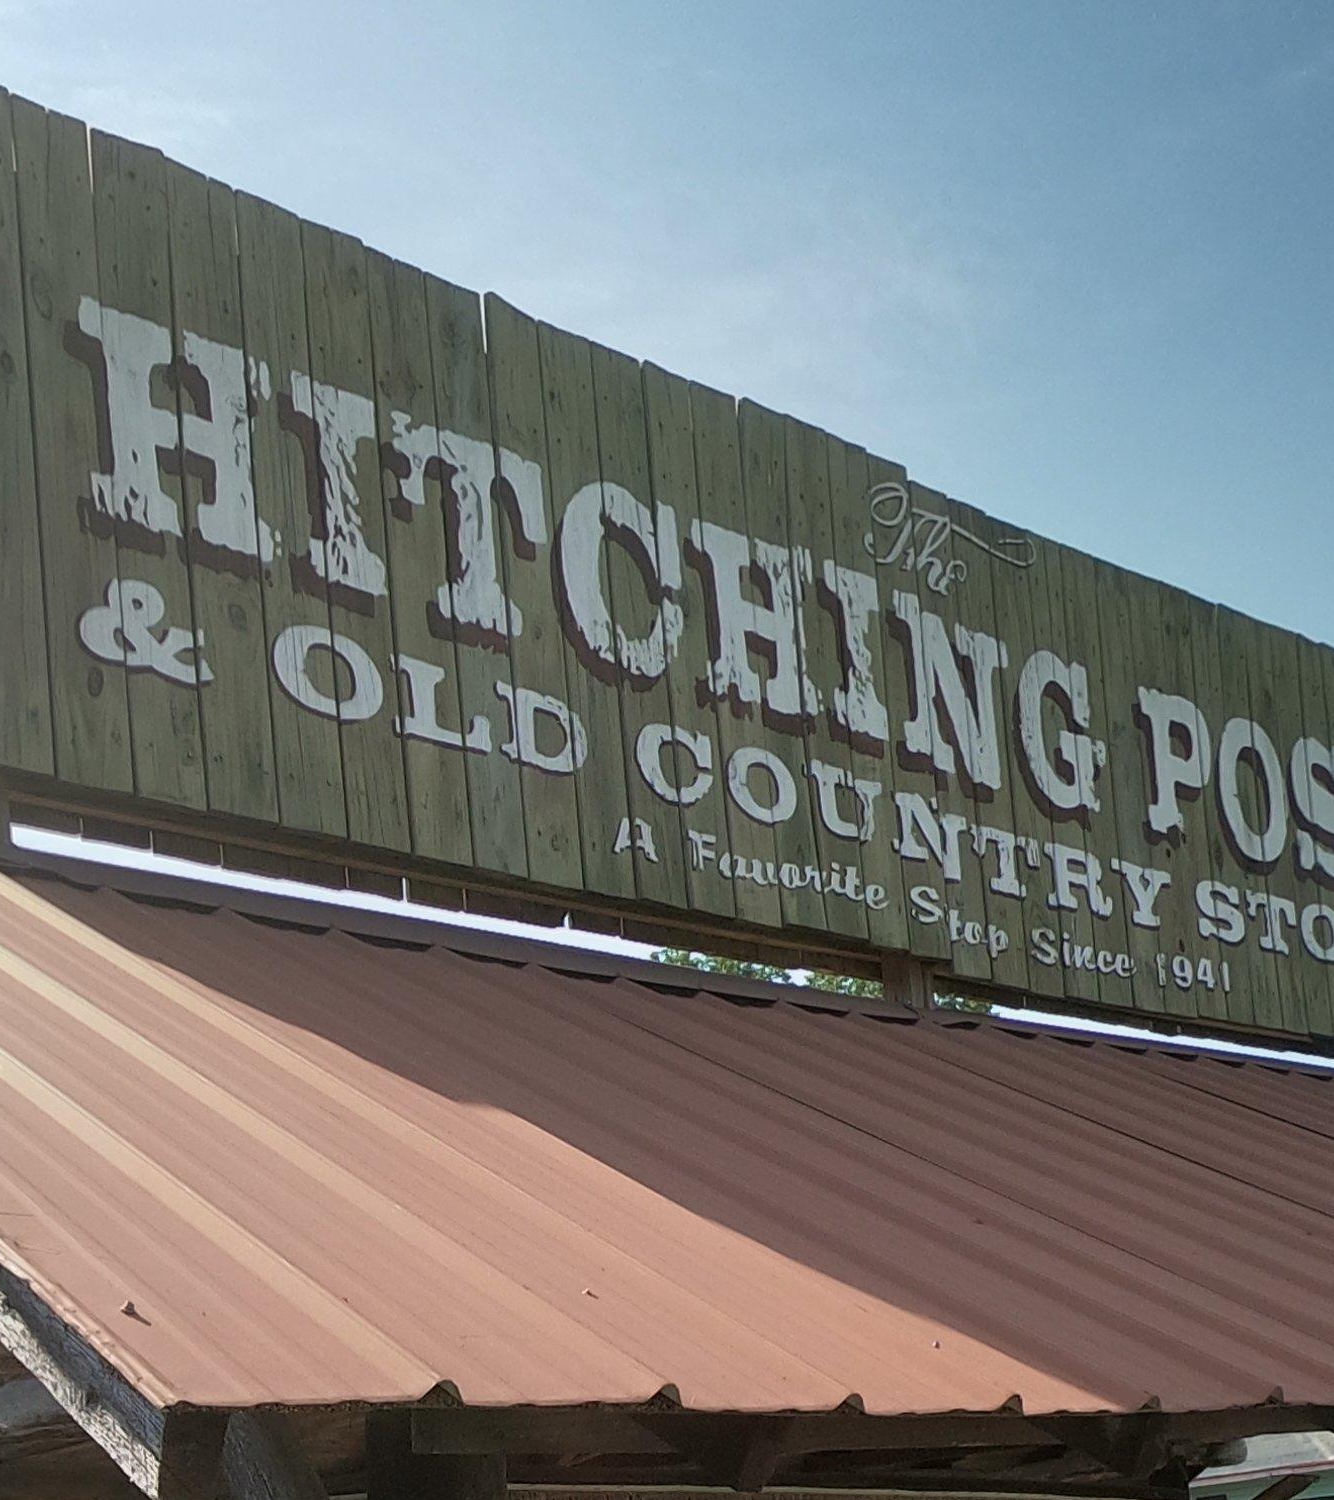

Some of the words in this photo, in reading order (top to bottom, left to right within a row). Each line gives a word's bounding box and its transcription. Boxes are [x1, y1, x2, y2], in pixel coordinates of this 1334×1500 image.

[75, 294, 1108, 815] HITCHING
[864, 482, 1036, 596] The
[77, 577, 215, 685] &
[272, 624, 590, 776] OLD
[635, 722, 1172, 931] COUNTRY
[613, 816, 659, 865] A
[686, 829, 890, 912] Favorite
[910, 886, 1010, 960] Stop
[1030, 928, 1137, 979] Since
[1157, 950, 1231, 993] 1941
